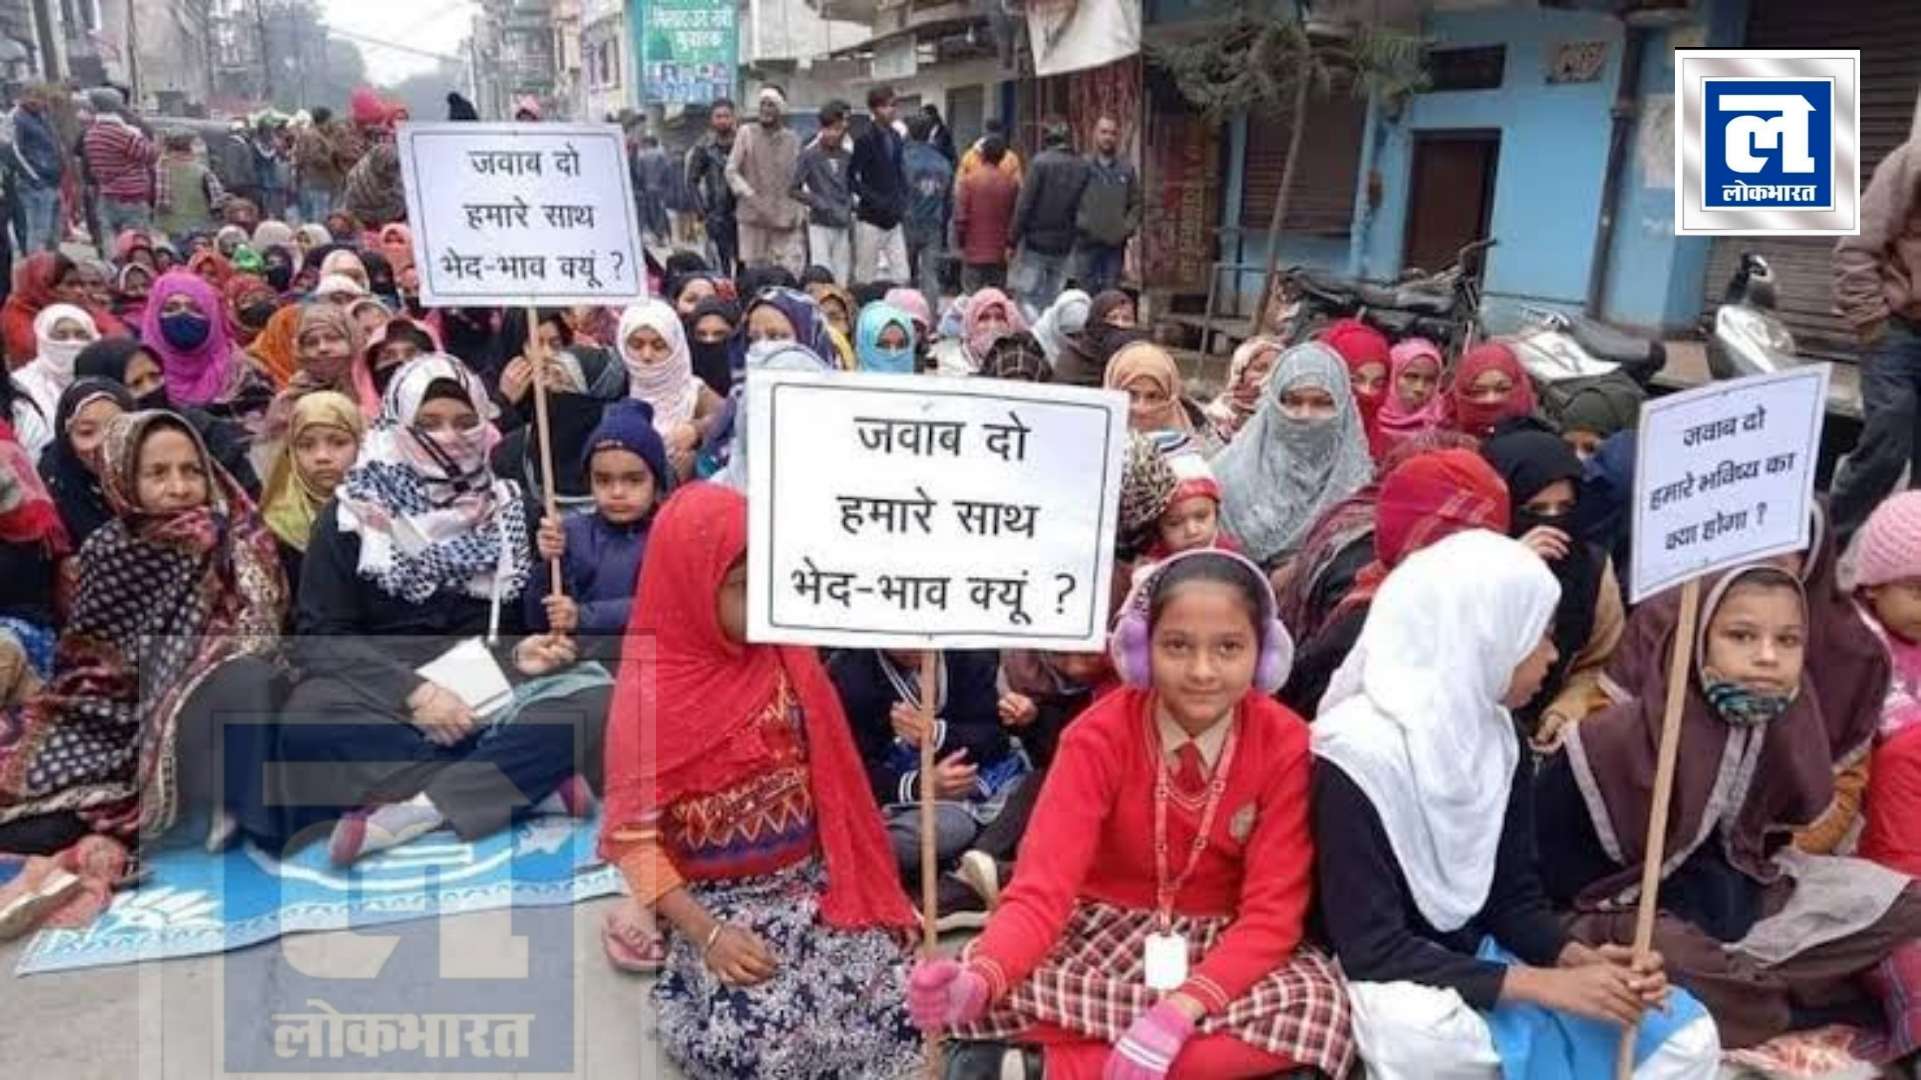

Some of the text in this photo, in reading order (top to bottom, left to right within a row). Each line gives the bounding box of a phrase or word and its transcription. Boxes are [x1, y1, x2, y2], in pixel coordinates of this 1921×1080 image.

[468, 140, 580, 177] जवाब दो
[462, 196, 594, 230] हमारे साथ
[441, 247, 624, 288] भेद-भाव क्यूं ?
[853, 411, 1031, 461] जवाब दो
[1683, 404, 1767, 446] जवाब दो
[1650, 452, 1798, 511] हमारे भविष्य का
[836, 487, 1041, 538] हमारे साथ
[1665, 501, 1768, 550] क्या होगा ?
[791, 556, 1076, 625] भेद-भाव क्यूं ?
